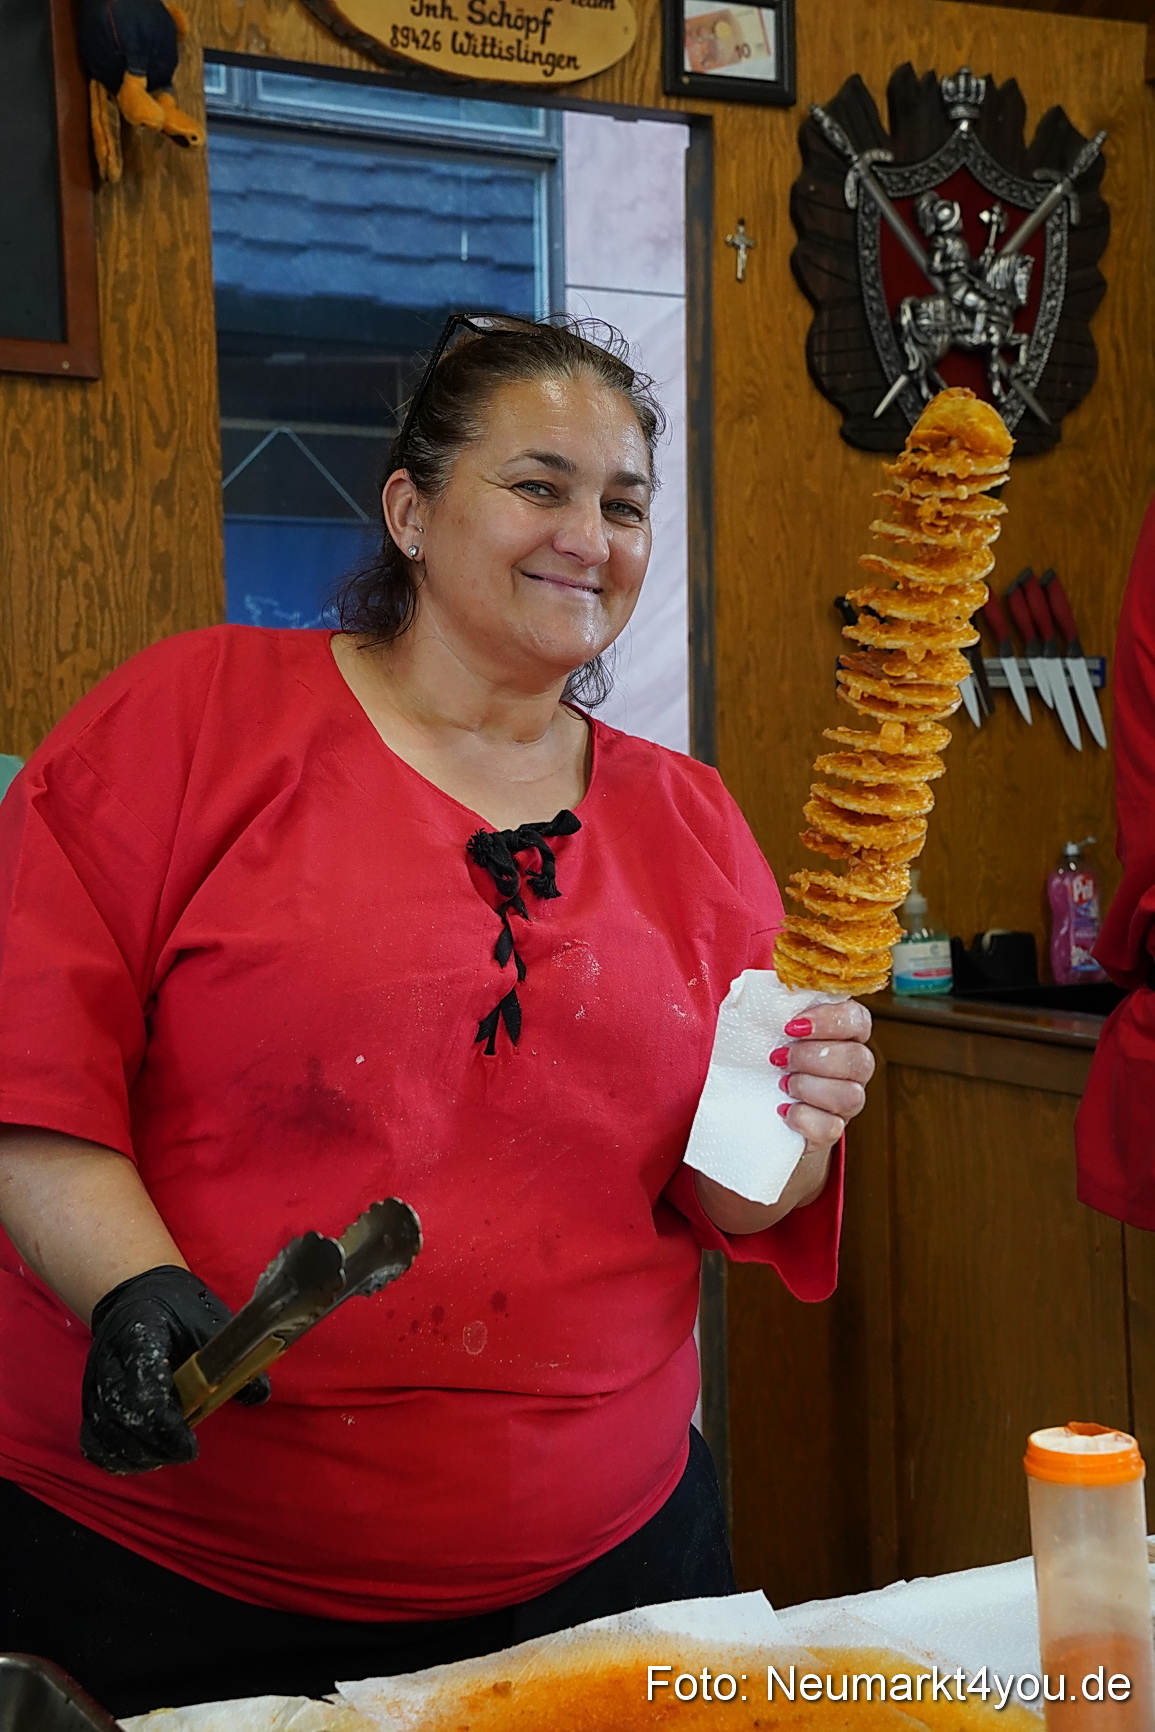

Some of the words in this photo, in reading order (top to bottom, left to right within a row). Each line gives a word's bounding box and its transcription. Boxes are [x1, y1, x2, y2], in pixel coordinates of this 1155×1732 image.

[467, 0, 554, 45] Schöpf
[390, 24, 442, 52] 89426
[451, 30, 580, 77] Wittislingen
[734, 42, 752, 60] 10
